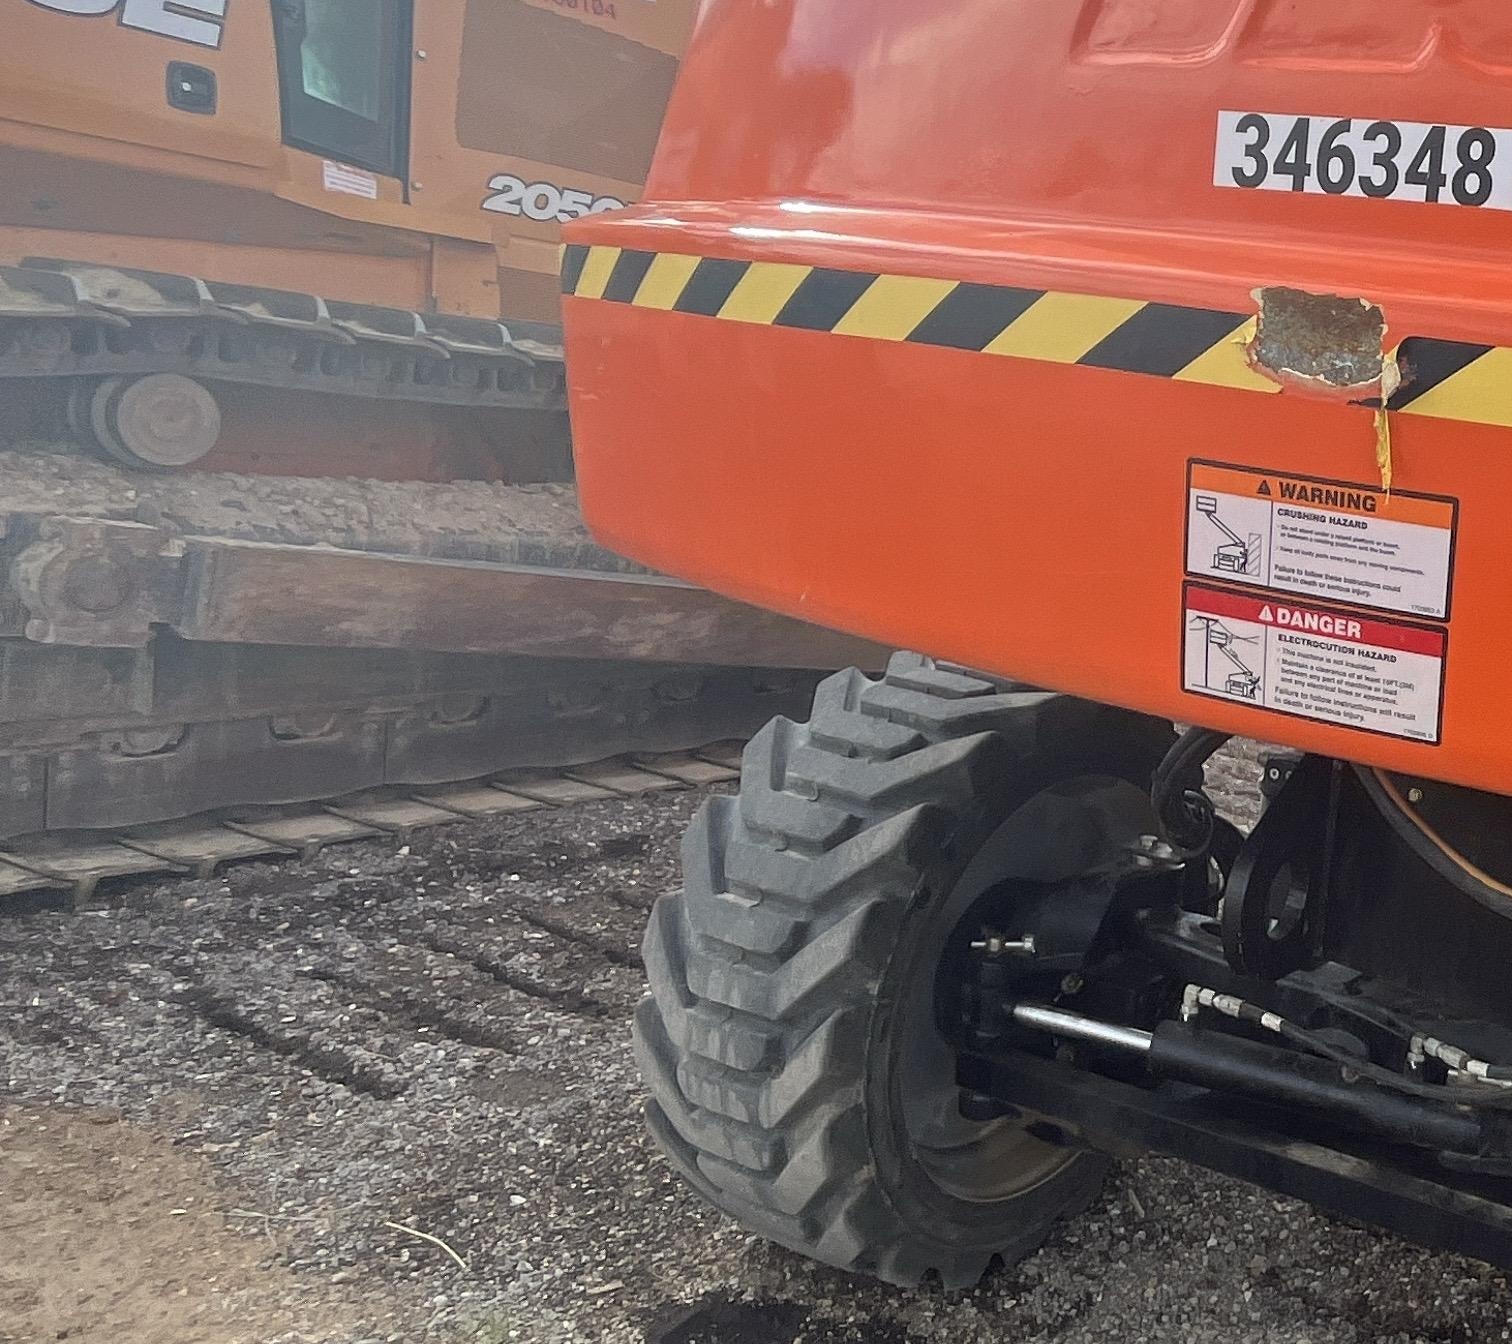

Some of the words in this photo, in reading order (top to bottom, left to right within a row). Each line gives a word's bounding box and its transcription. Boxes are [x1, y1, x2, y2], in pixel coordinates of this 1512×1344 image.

[1231, 111, 1496, 207] 346348
[1278, 481, 1377, 513] WARNING
[1277, 508, 1326, 523] CRUSHING
[1329, 516, 1368, 530] HAZARD
[1277, 607, 1362, 639] DANGER
[1278, 633, 1355, 656] ELECTROCUTION
[1358, 647, 1397, 664] HAZARD
